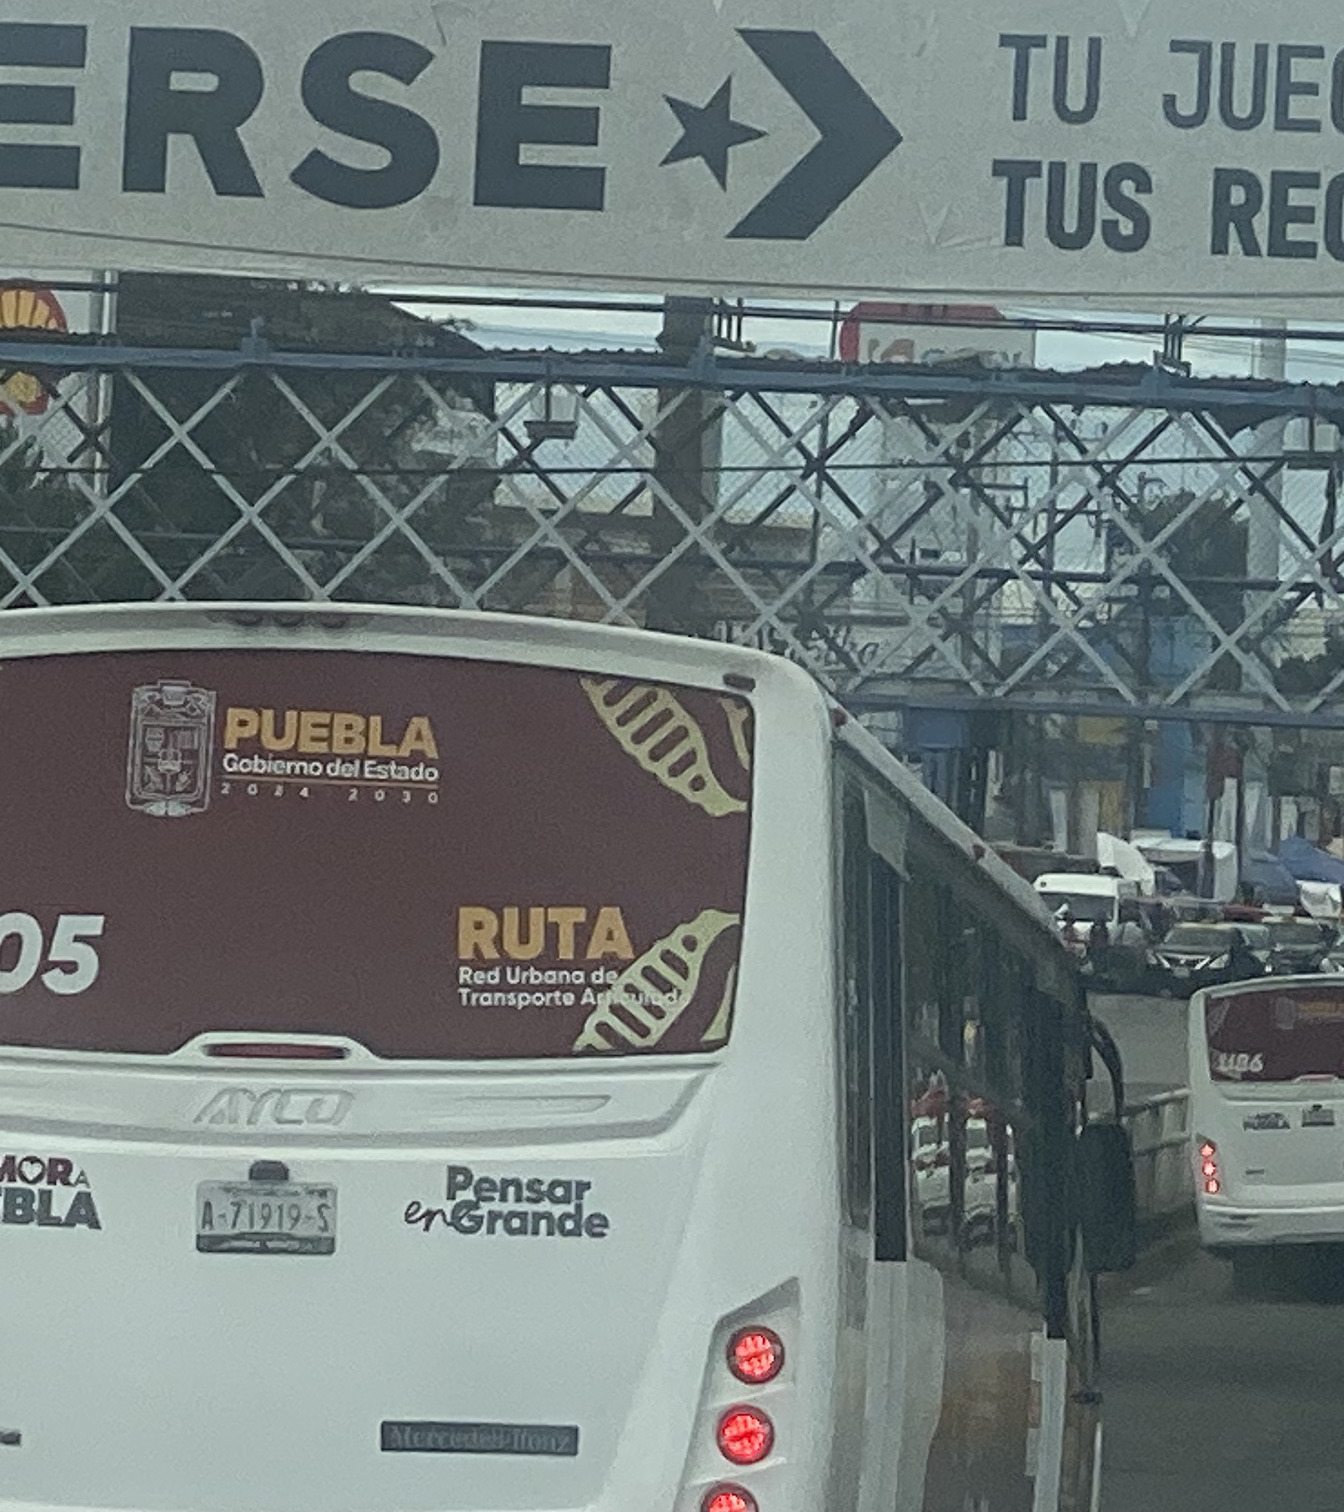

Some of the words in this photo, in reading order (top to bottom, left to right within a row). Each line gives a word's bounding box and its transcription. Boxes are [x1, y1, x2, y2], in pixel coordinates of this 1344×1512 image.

[998, 32, 1103, 126] TU
[991, 158, 1154, 253] TUS
[223, 707, 440, 760] PUEBLA
[222, 752, 324, 776] Gobierno
[326, 757, 360, 778] del
[363, 759, 439, 782] Estado
[458, 906, 636, 961] RUTA
[458, 966, 500, 985] Red
[505, 965, 586, 986] Urbana
[590, 966, 618, 985] de
[458, 987, 576, 1010] Transporte
[72, 1168, 91, 1189] A
[446, 1164, 593, 1205] Pensar
[404, 1199, 457, 1232] en
[452, 1199, 611, 1239] Grande
